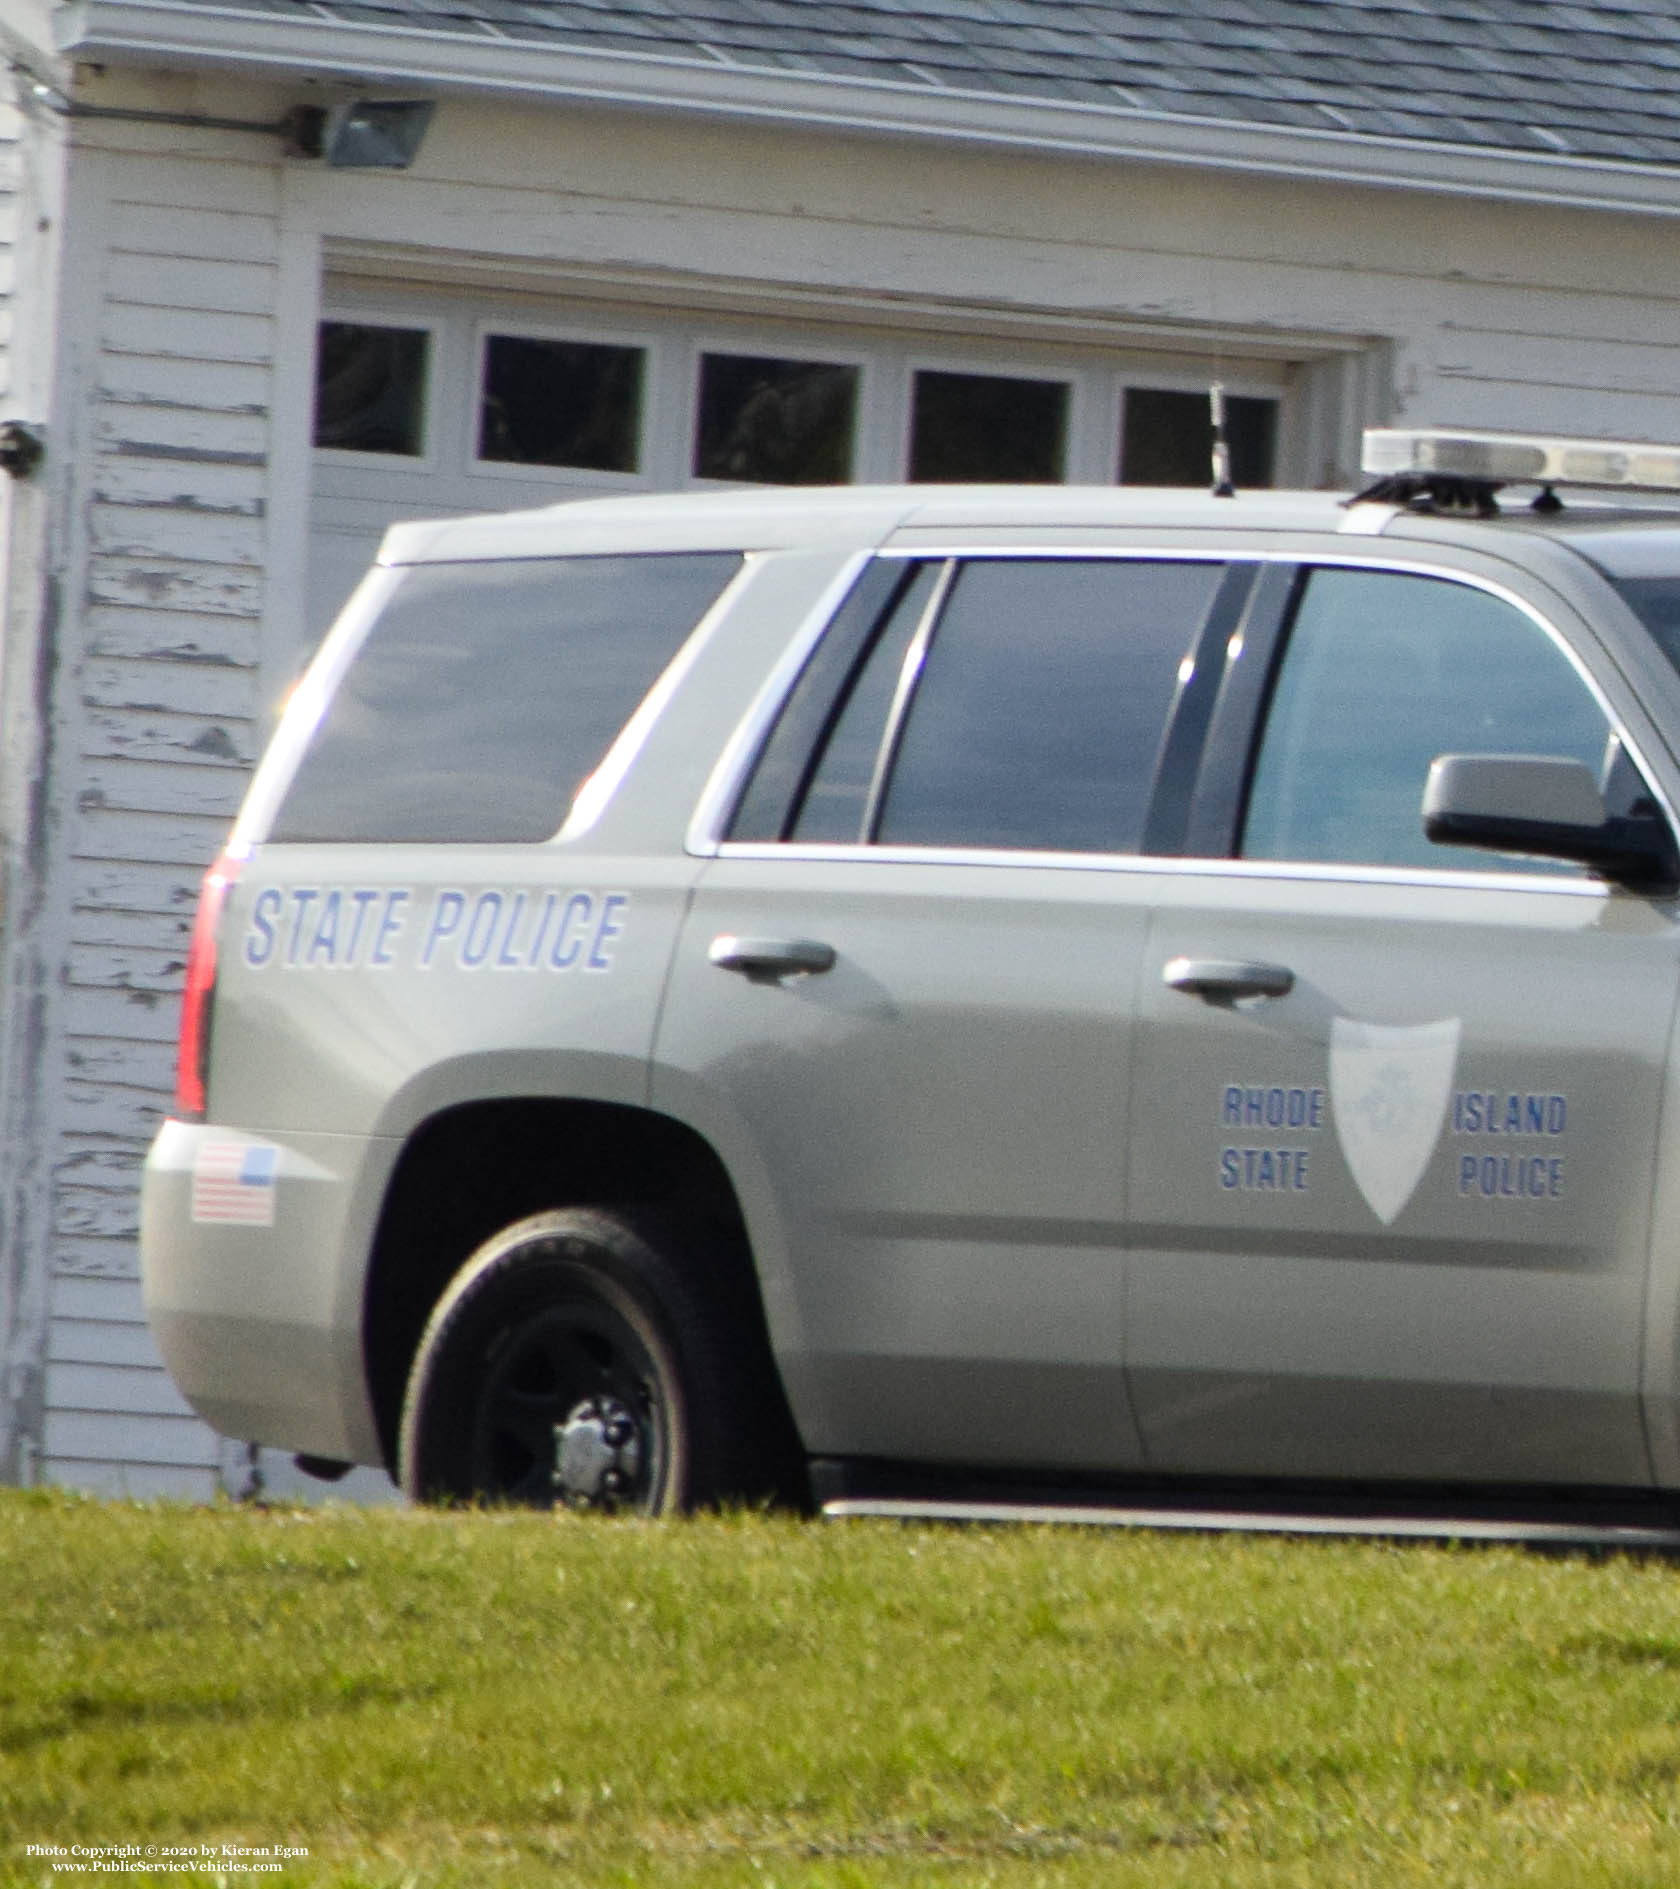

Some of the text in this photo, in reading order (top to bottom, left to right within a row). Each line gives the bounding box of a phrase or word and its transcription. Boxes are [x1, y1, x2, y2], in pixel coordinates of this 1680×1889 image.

[245, 887, 630, 971] STATE POLICE
[1223, 1085, 1567, 1135] RHODE ISLAND
[1221, 1147, 1563, 1199] STATE POLICE
